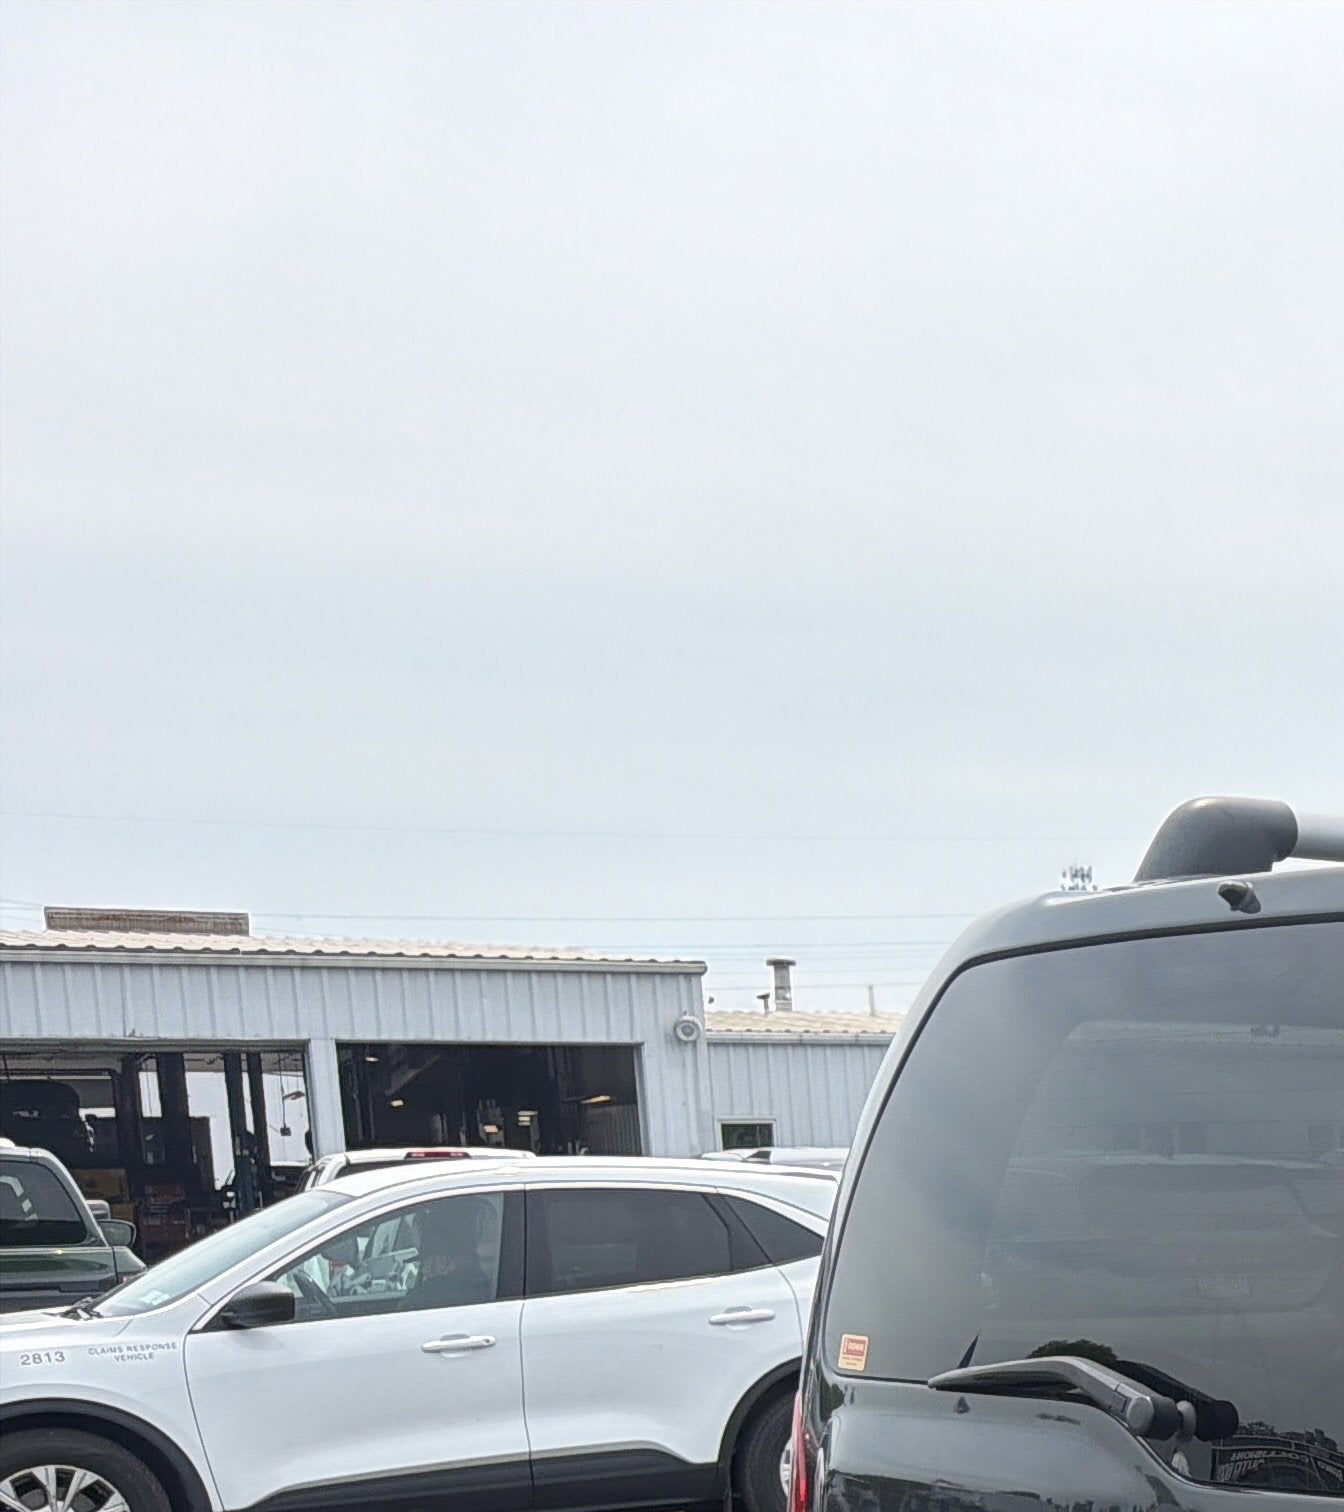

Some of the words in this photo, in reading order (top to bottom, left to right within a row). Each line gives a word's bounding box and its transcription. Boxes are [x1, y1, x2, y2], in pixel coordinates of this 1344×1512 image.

[88, 1346, 123, 1356] CLAIMS
[126, 1341, 178, 1352] RESPONSE
[20, 1350, 66, 1367] 2813
[114, 1352, 155, 1363] VEHICLE
